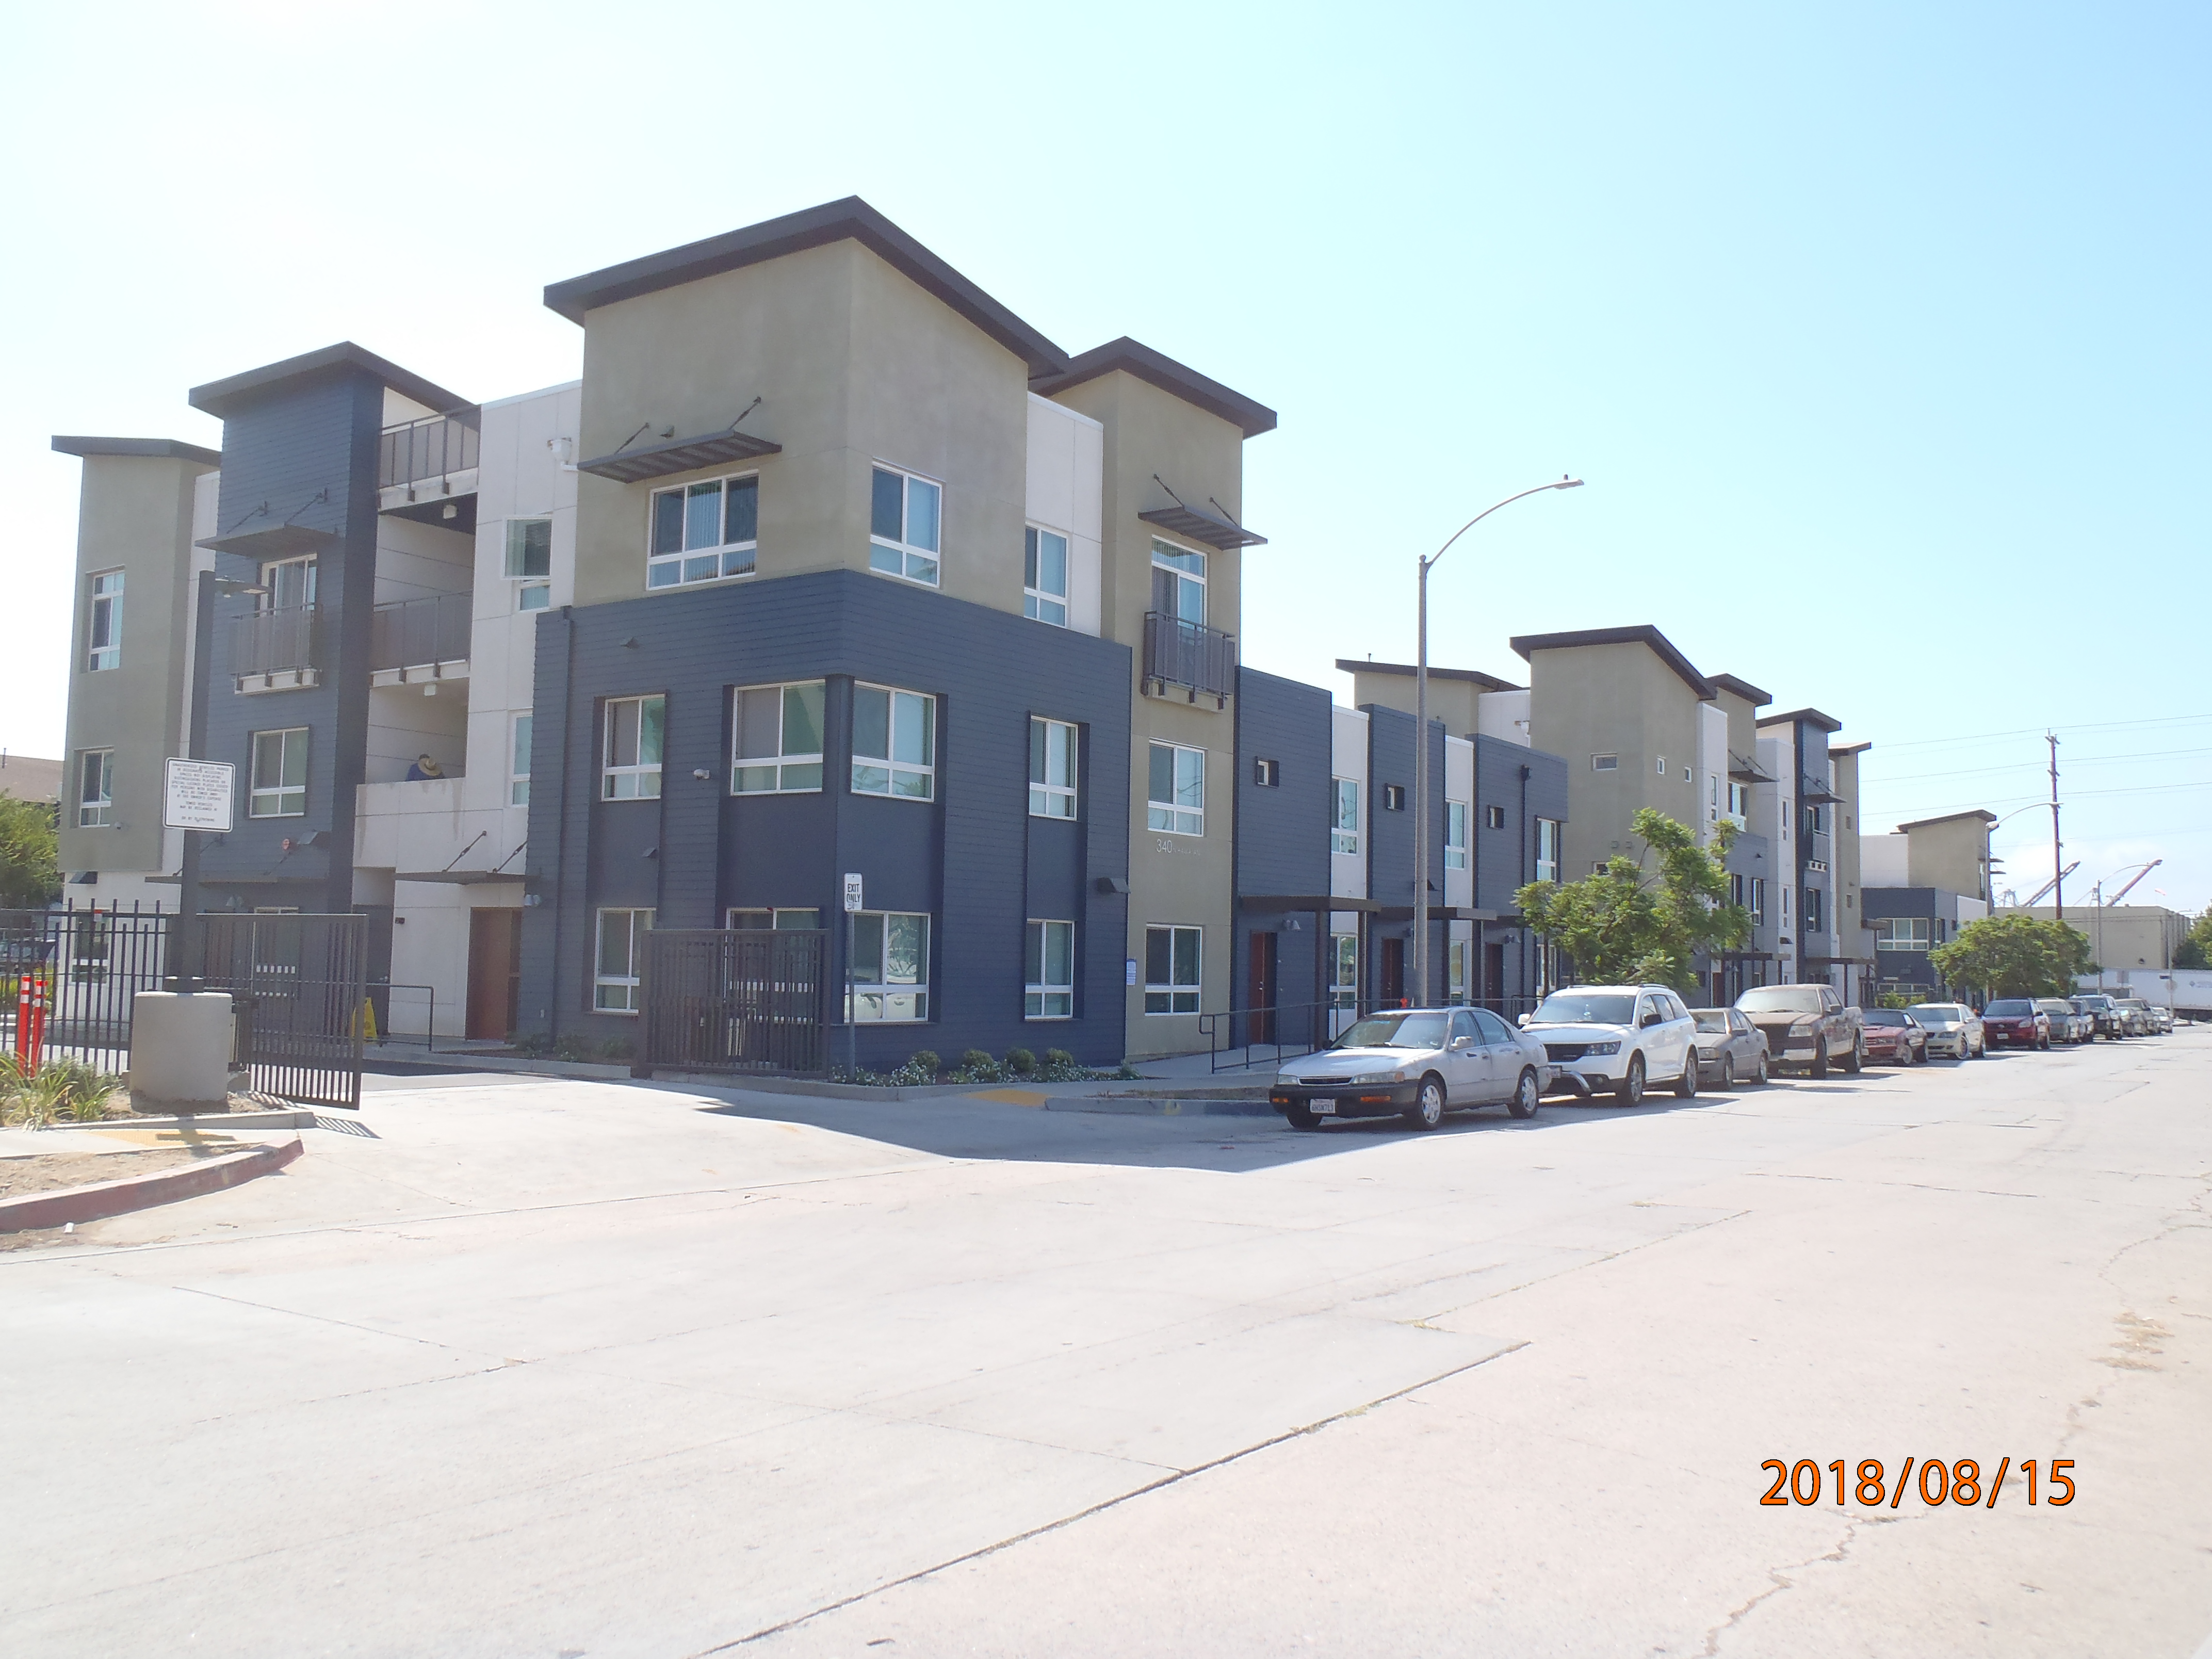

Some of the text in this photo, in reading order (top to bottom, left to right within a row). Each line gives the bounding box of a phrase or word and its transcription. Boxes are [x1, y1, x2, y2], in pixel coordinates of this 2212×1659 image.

[1156, 838, 1172, 853] 340
[848, 883, 859, 892] EXIT
[847, 893, 860, 902] ONLY
